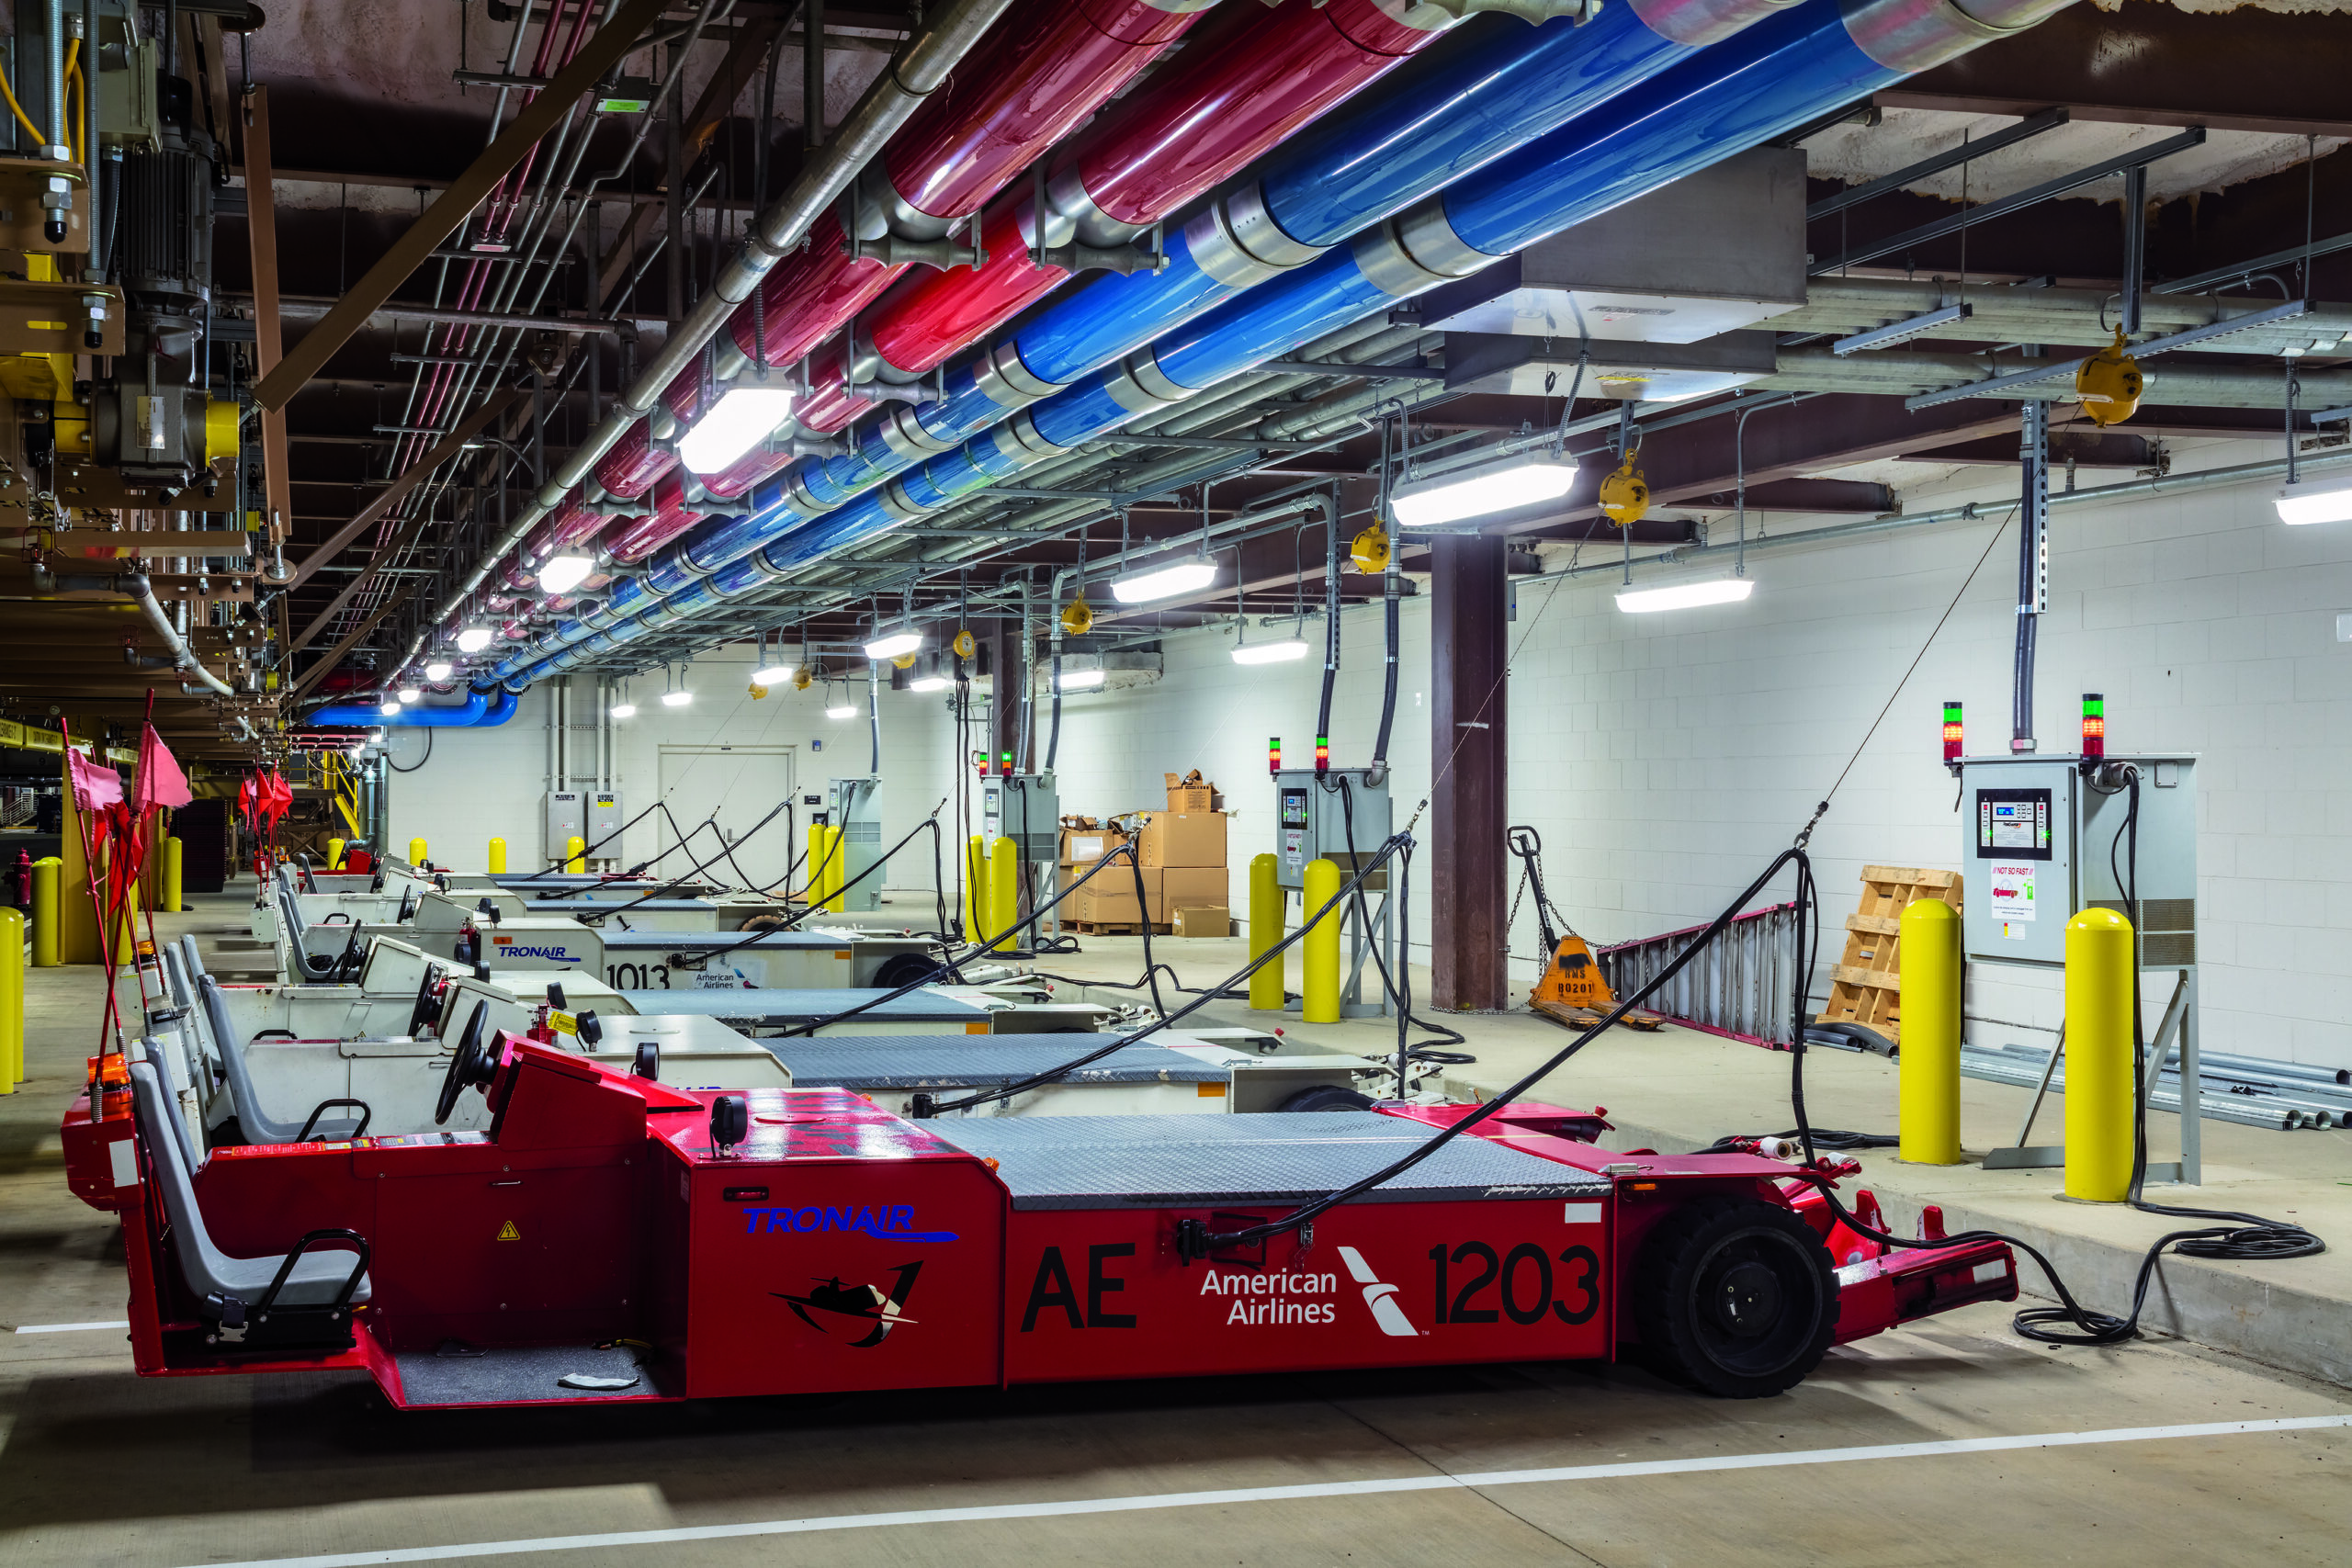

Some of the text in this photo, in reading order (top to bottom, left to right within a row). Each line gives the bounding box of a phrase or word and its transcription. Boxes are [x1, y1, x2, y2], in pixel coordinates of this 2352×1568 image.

[2008, 867, 2016, 875] SO
[499, 946, 566, 958] TRONAIR
[606, 963, 670, 990] 1013
[704, 981, 734, 989] Airlines
[742, 1204, 915, 1234] TRONAIR
[1020, 1243, 1137, 1333] AE
[1200, 1268, 1337, 1296] American
[1428, 1240, 1601, 1325] 1203
[1227, 1297, 1336, 1325] Airlines
